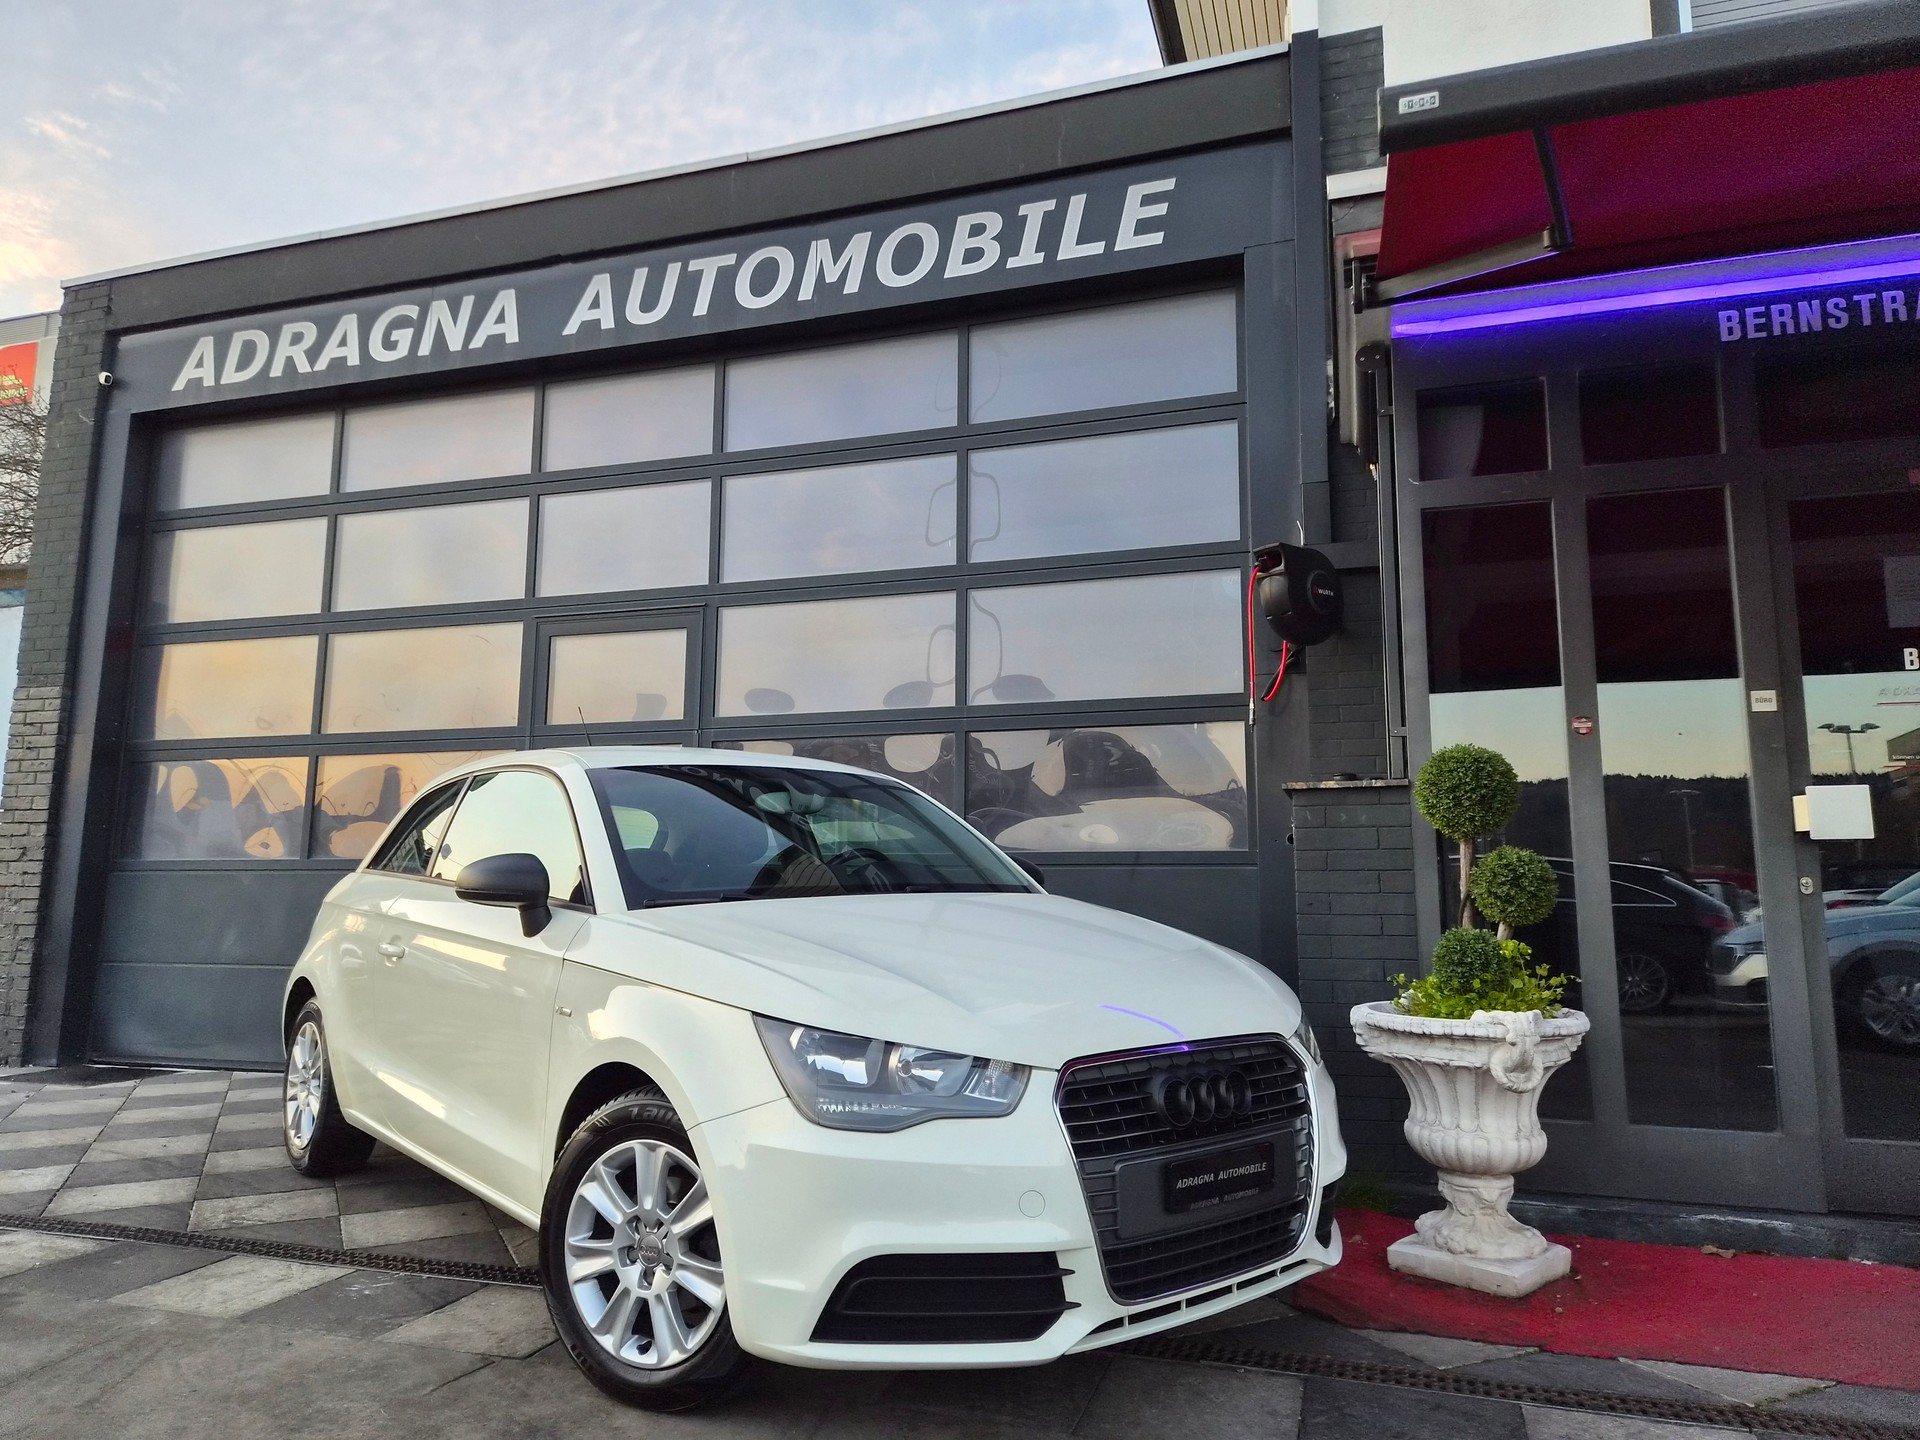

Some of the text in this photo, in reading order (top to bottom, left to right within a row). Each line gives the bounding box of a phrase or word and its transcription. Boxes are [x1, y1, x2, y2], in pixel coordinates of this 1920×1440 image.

[171, 177, 1177, 392] ADRAGNA AUTOMOBILE
[1718, 288, 1920, 342] BERNSTR
[1176, 1162, 1267, 1189] ADRAGNA AUTOMOBILE
